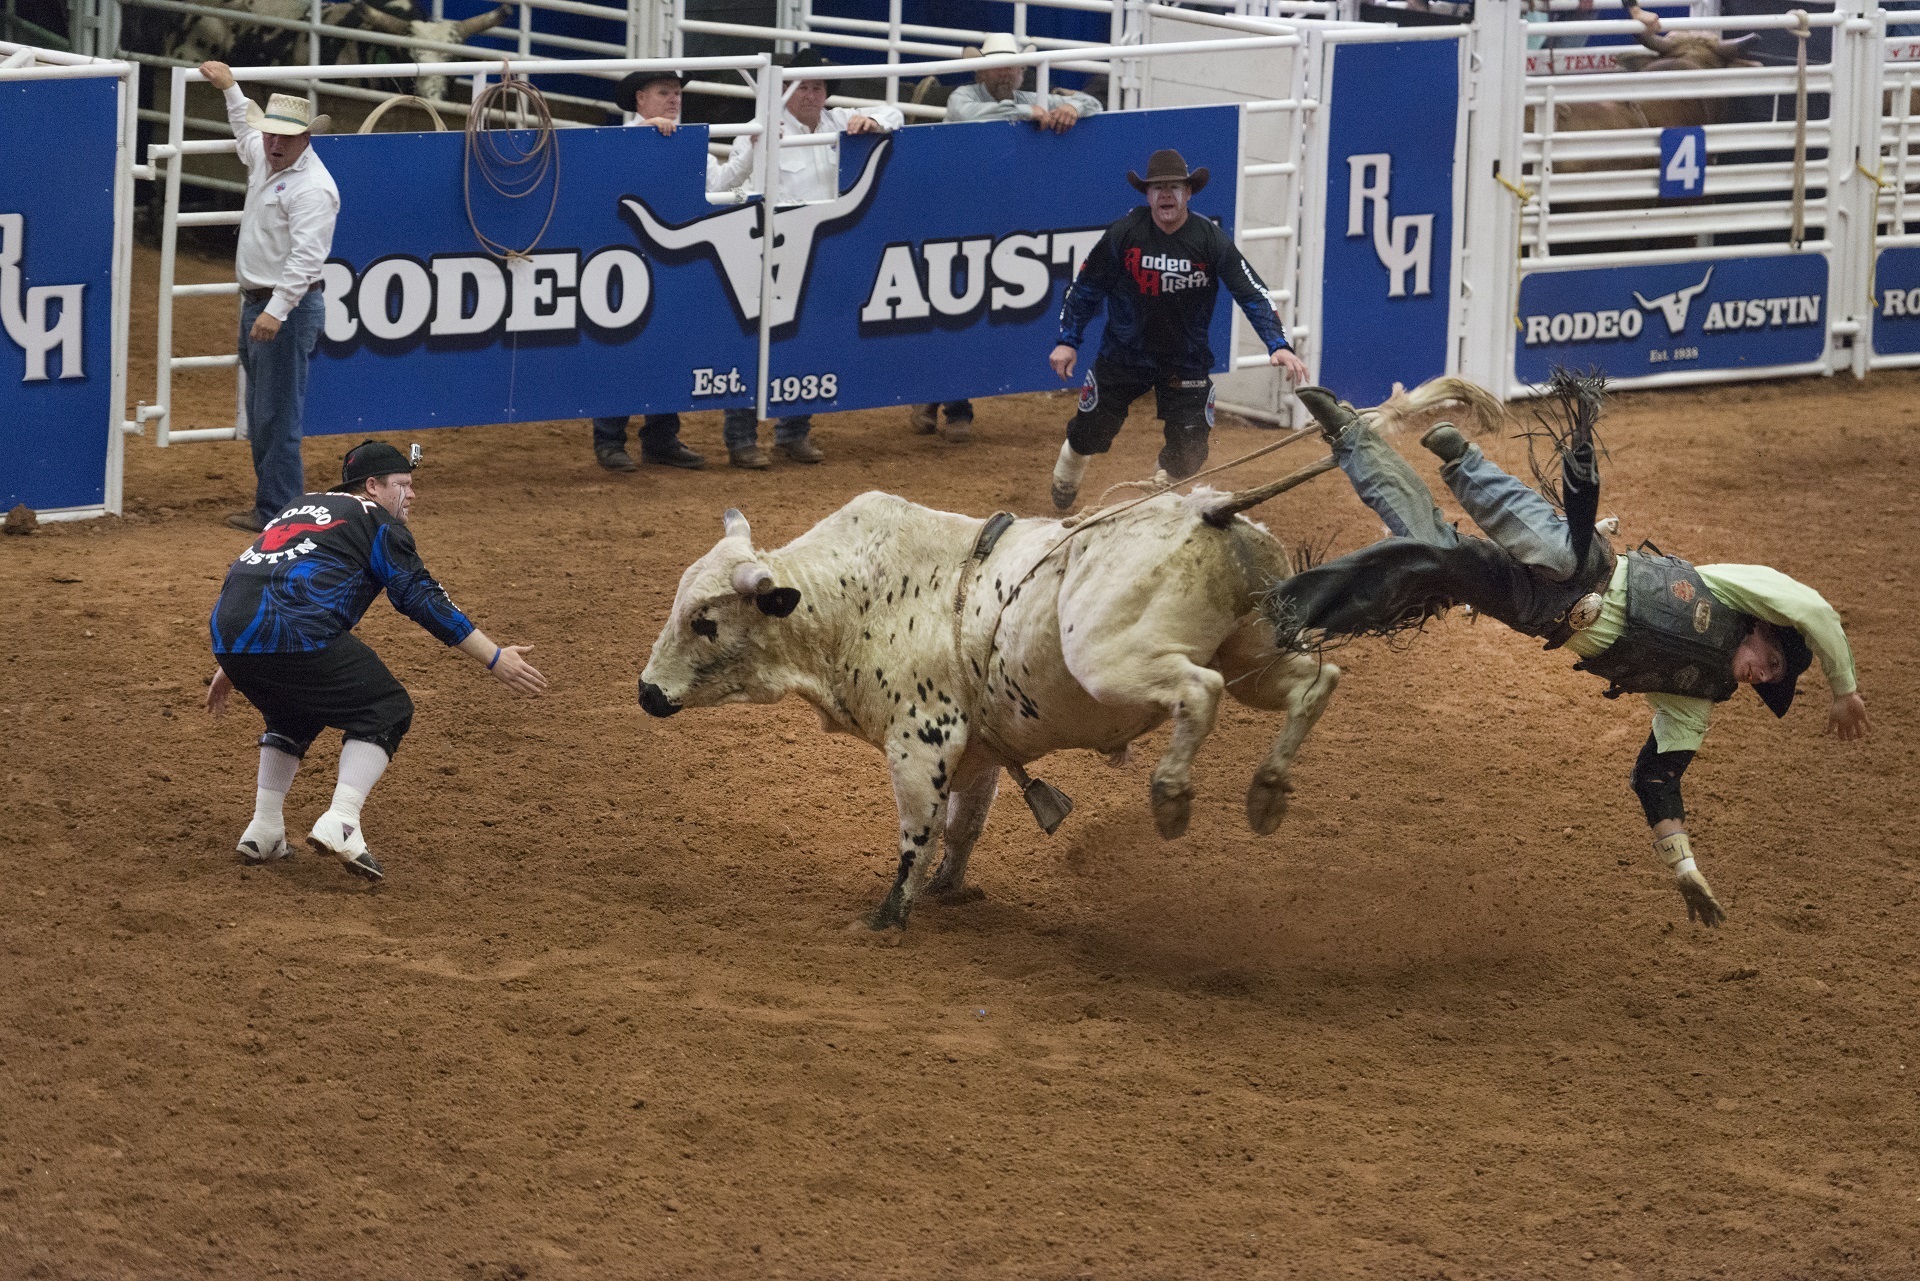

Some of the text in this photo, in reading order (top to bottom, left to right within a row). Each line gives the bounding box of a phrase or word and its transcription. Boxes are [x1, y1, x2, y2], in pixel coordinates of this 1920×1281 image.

[1564, 53, 1617, 71] TEXAS
[1666, 134, 1700, 190] 4
[862, 229, 1107, 322] AUST
[1525, 295, 1821, 344] RODEO AUSTIN
[691, 368, 838, 402] Est. 1938
[239, 538, 318, 565] USTIN
